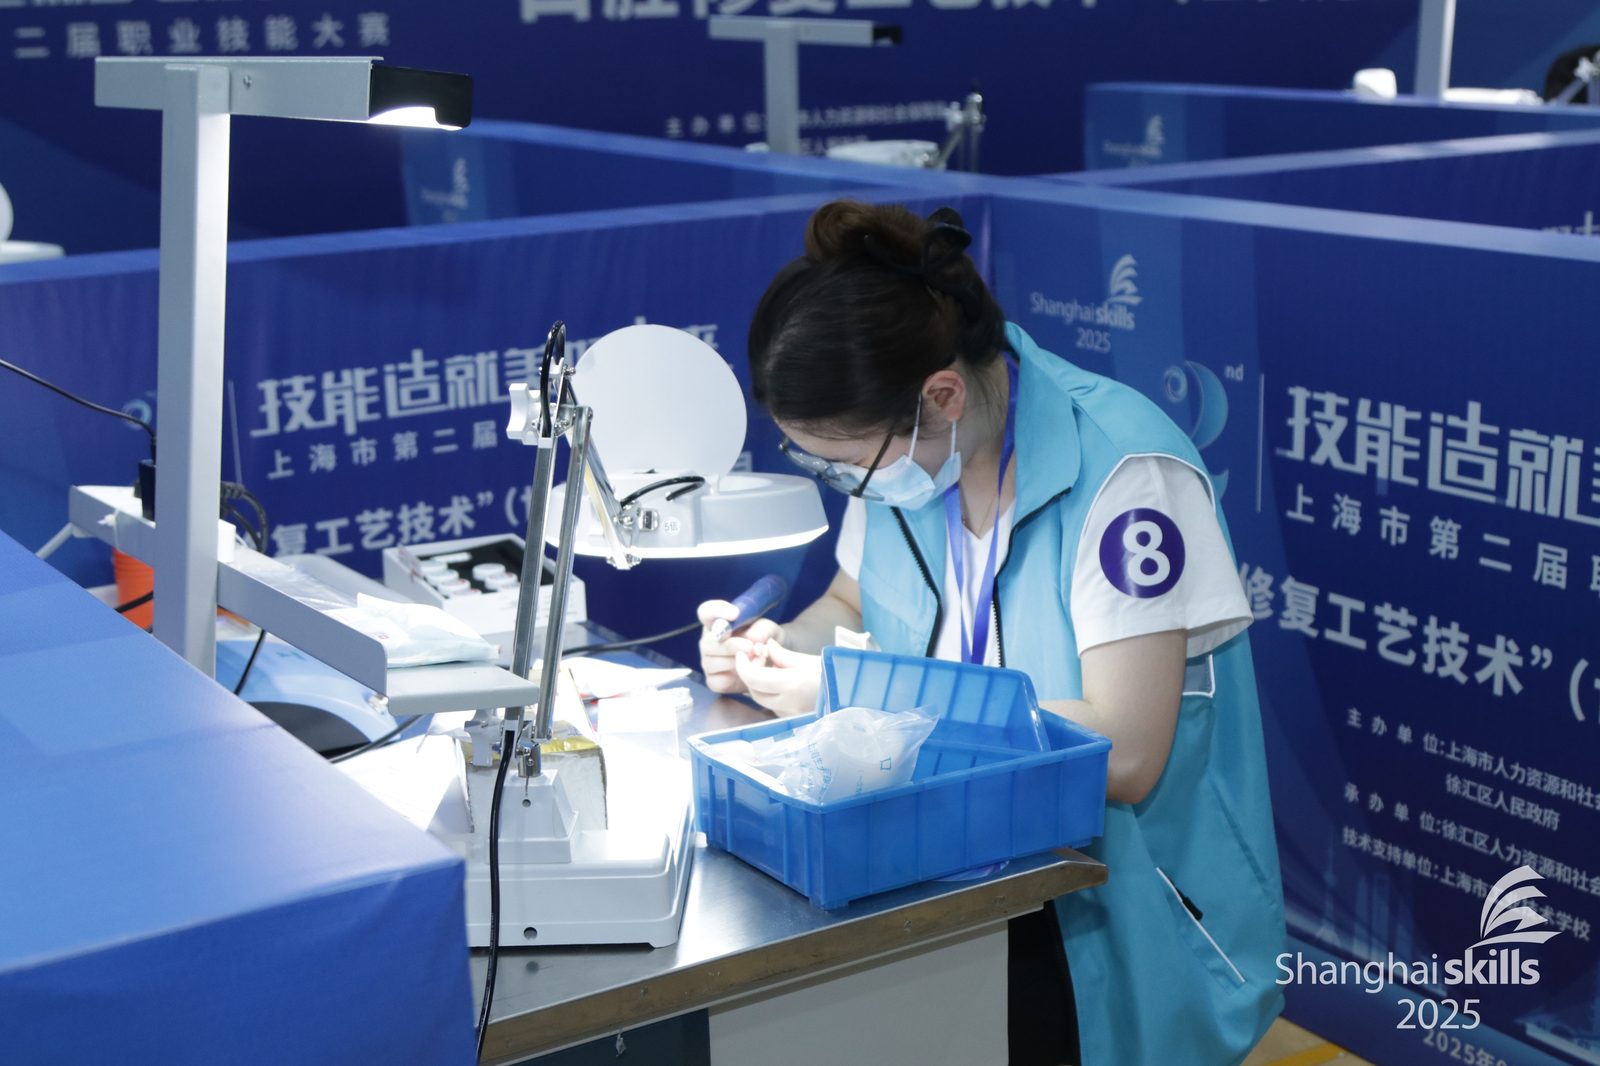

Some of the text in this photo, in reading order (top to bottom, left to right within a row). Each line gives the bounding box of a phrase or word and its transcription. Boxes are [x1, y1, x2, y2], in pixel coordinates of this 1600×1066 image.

[1076, 327, 1111, 353] 2025
[1276, 386, 1600, 527] 技能造就
[1123, 520, 1170, 586] 8
[1240, 562, 1600, 723] 修复工艺技术”(
[1446, 773, 1560, 831] 徐汇区人民政府
